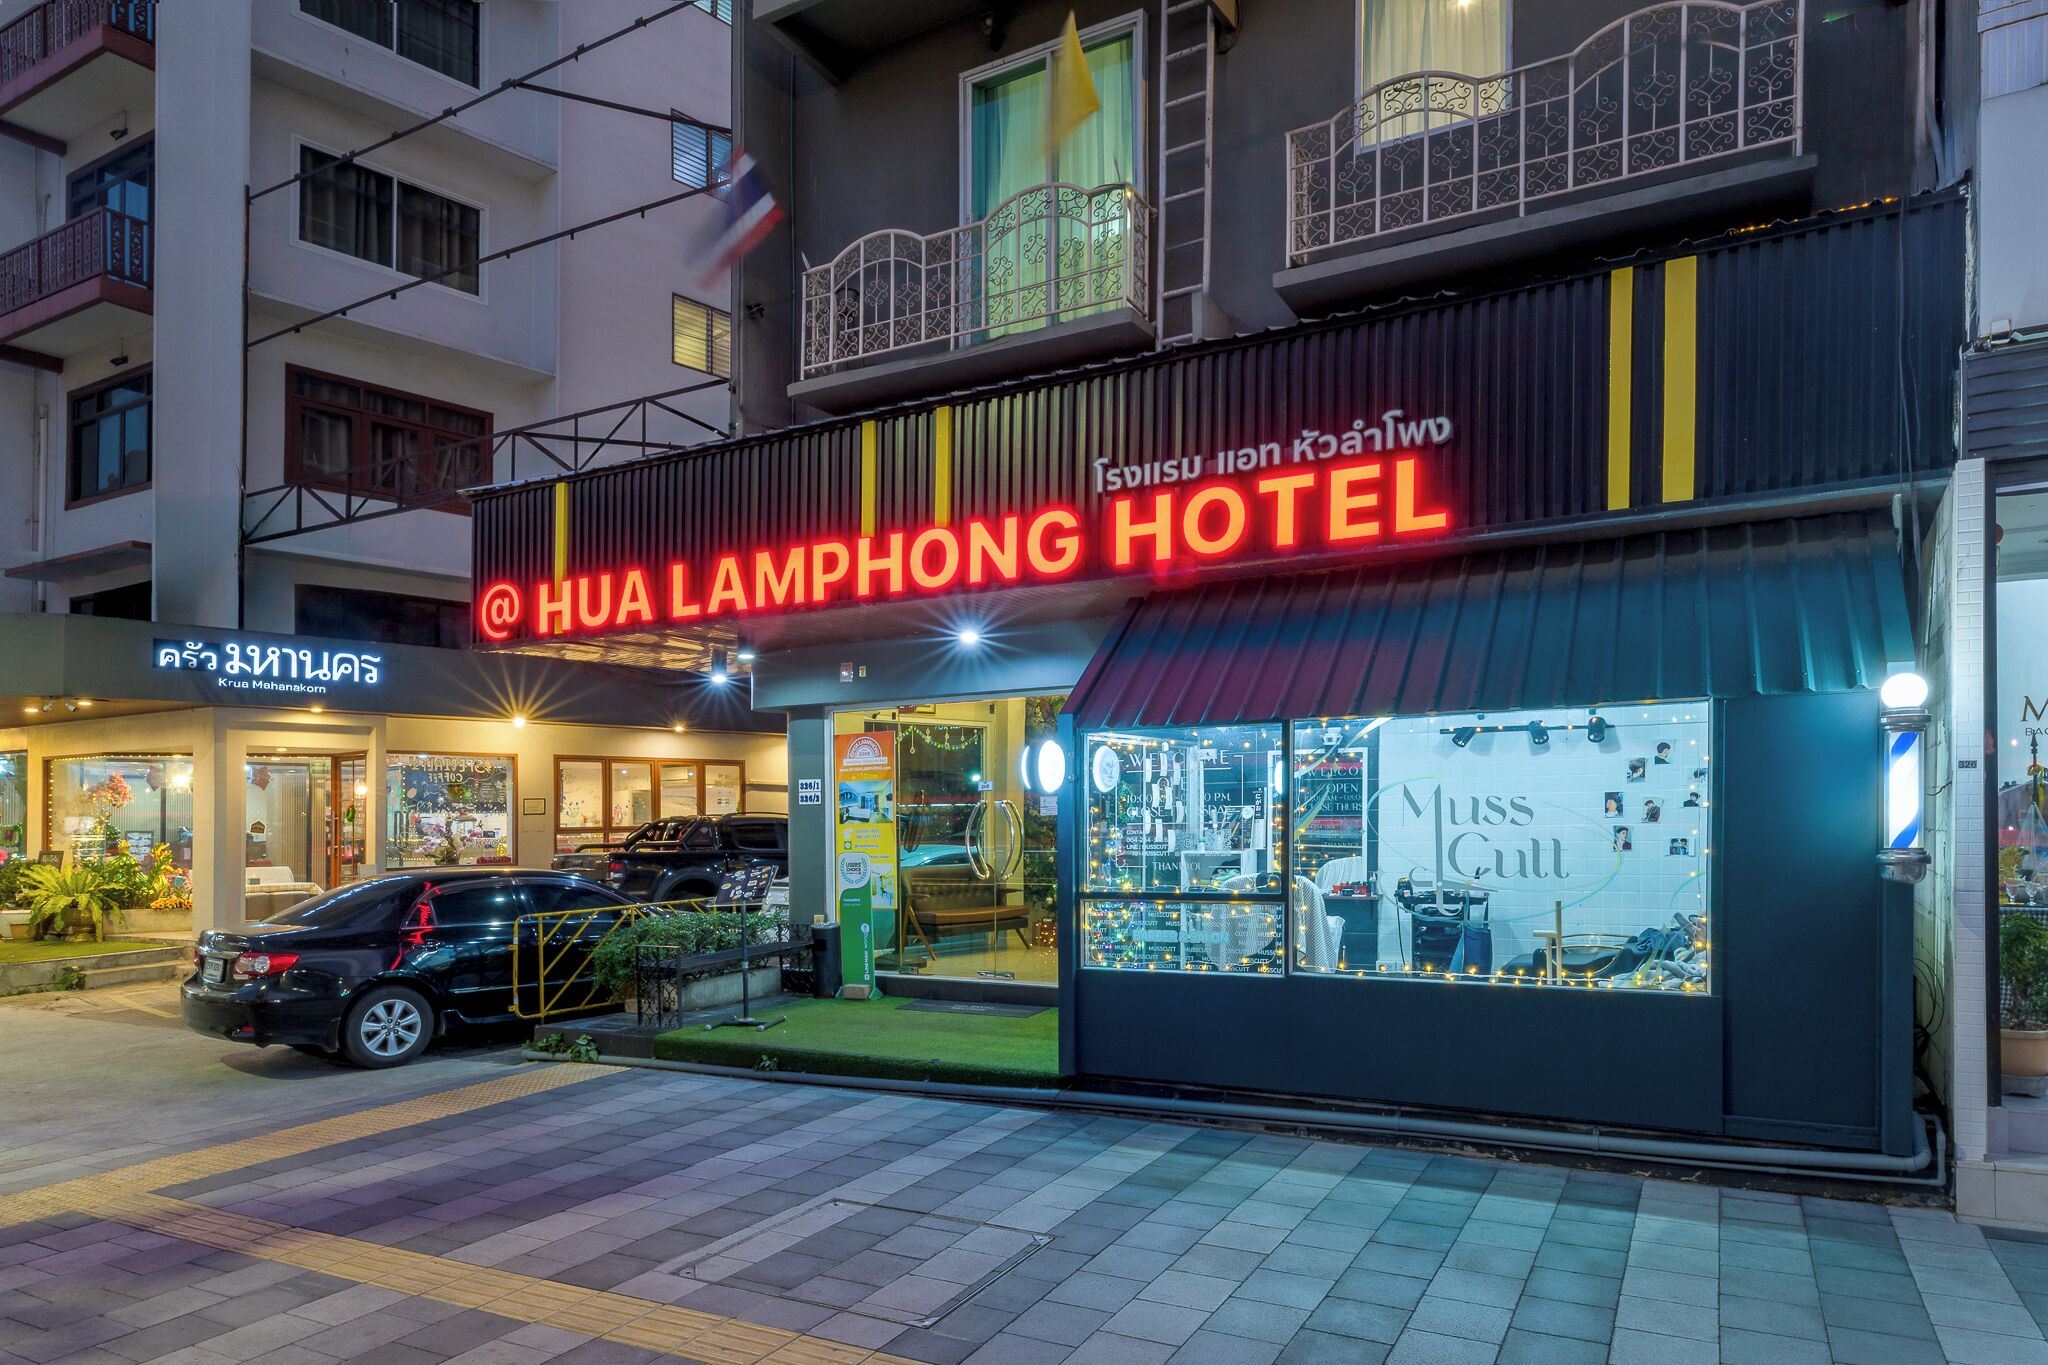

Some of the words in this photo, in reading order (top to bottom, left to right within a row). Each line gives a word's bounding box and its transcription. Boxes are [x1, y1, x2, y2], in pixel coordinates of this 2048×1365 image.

[1094, 455, 1202, 493] โรงแรม
[1217, 443, 1281, 476] แอท
[1292, 409, 1453, 464] หัวลำโพง
[480, 582, 521, 639] @
[538, 570, 653, 635] HUA
[671, 508, 1082, 618] LAMPHONG
[1114, 458, 1448, 567] HOTEL
[159, 641, 218, 671] ครัว
[225, 642, 381, 684] มหานคร
[218, 677, 249, 689] Krua
[252, 680, 327, 694] Mahanakorn
[1958, 760, 1977, 768] 326
[799, 780, 820, 790] 326/1
[799, 794, 820, 803] 326/2
[1447, 831, 1570, 879] Cutt
